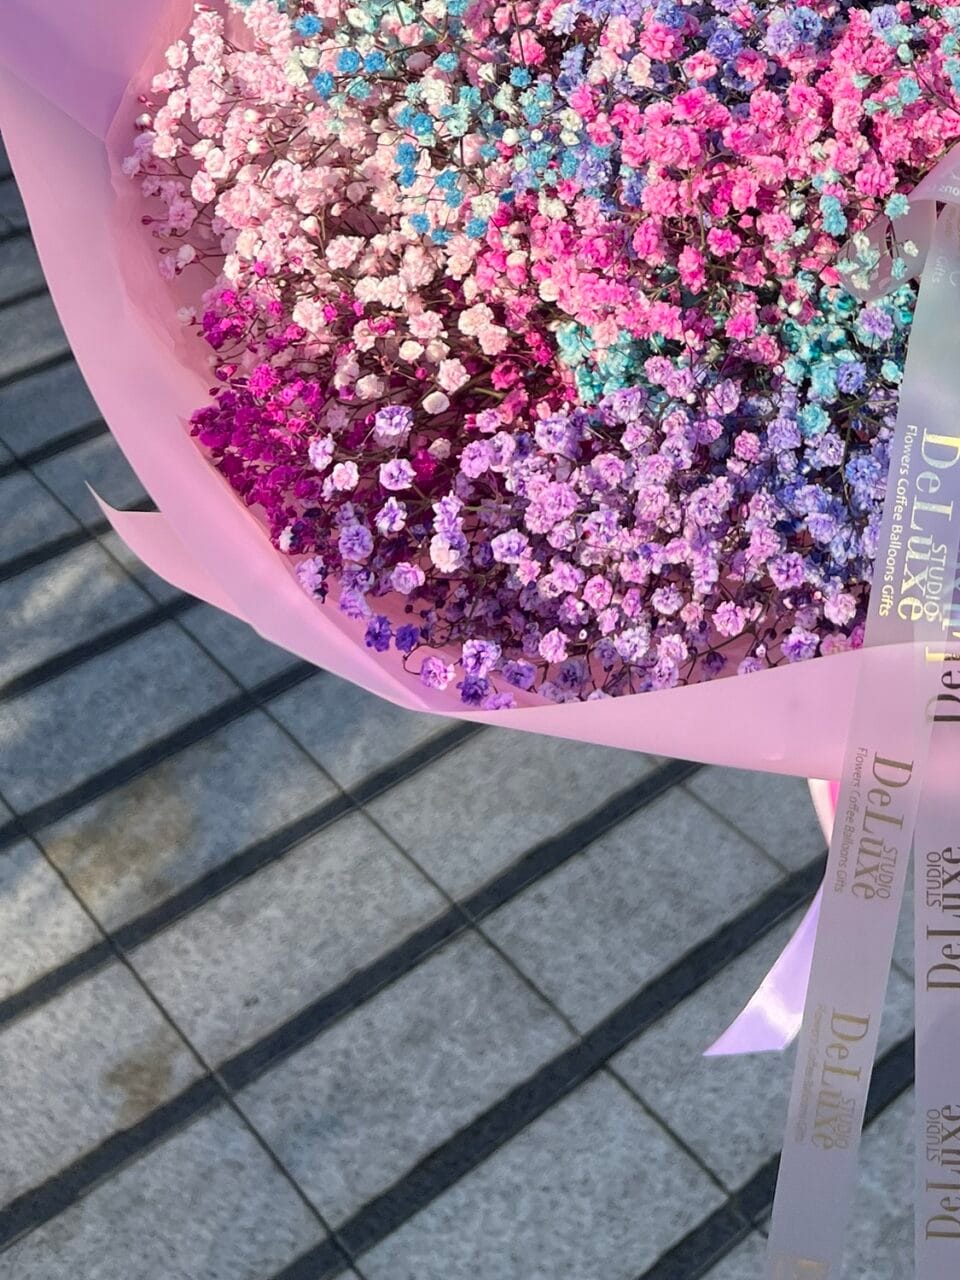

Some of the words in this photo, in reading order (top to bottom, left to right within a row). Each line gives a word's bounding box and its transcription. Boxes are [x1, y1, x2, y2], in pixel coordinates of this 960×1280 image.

[900, 424, 918, 475] Flowers
[892, 479, 909, 521] Coffee
[883, 523, 903, 582] Balloons
[924, 543, 947, 617] STUDIO
[879, 582, 894, 616] Gifts
[851, 747, 868, 787] Flowers
[838, 823, 855, 868] Balloons
[852, 752, 914, 900] DeLuxe
[834, 869, 848, 893] Gifts
[875, 845, 898, 900] STUDIO
[926, 851, 942, 908] STUDIO
[811, 1006, 871, 1150] DeLuxe
[926, 1108, 941, 1163] STUDIO
